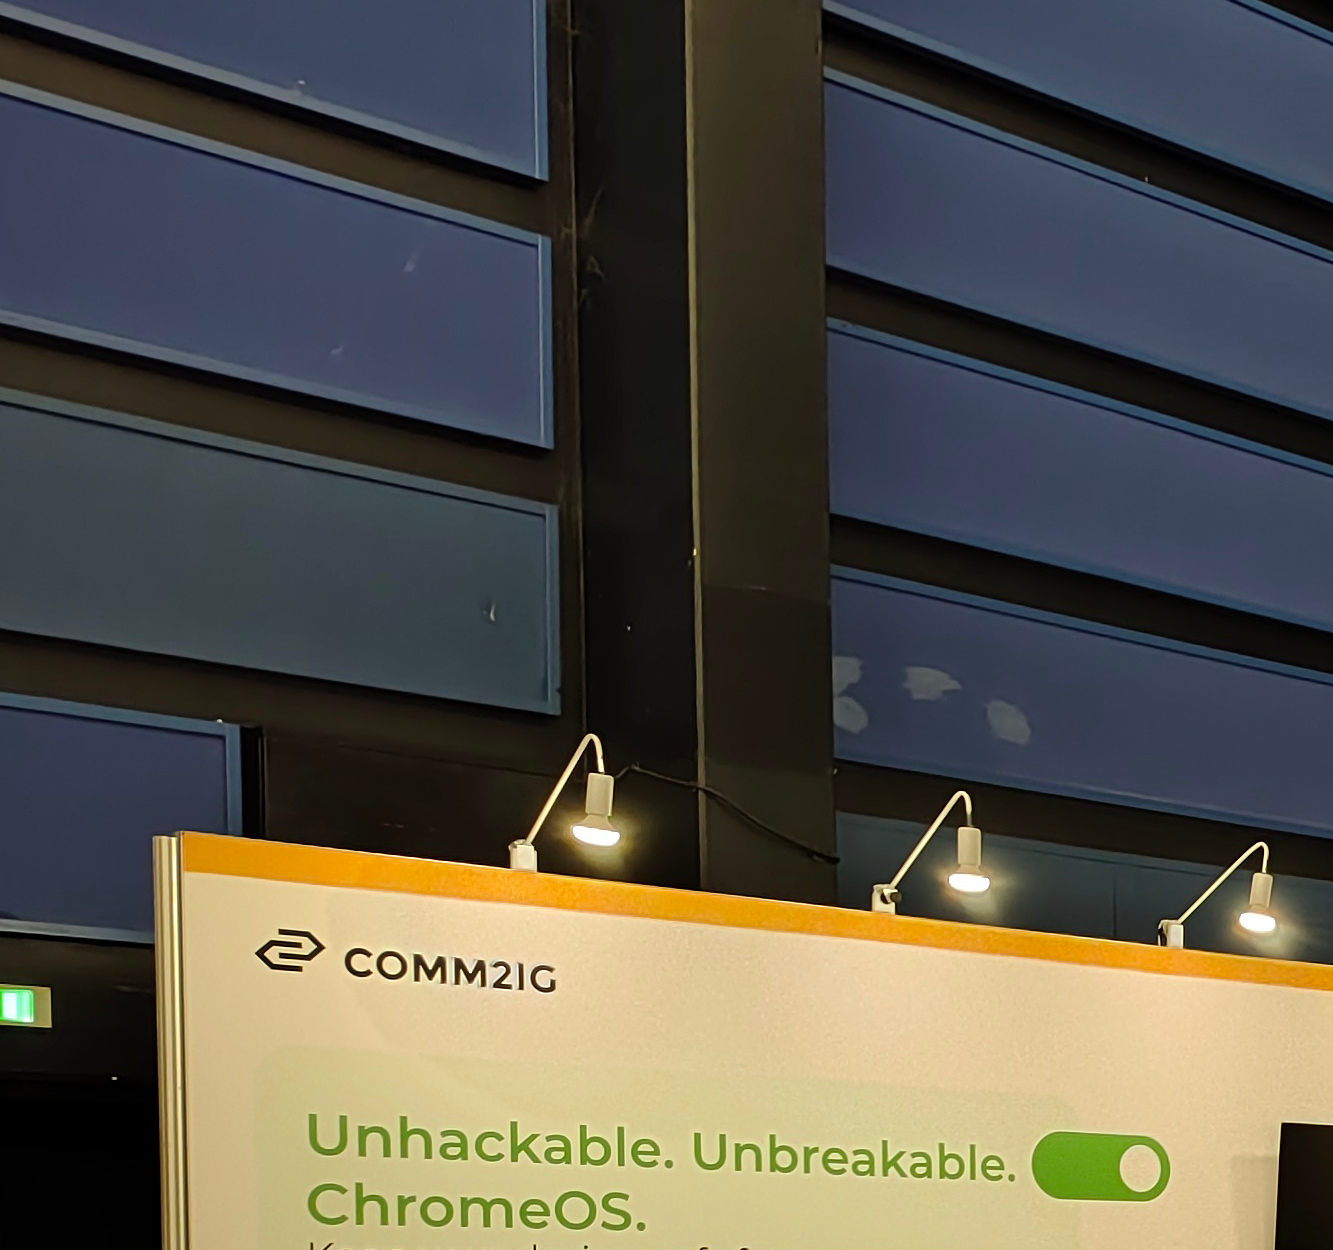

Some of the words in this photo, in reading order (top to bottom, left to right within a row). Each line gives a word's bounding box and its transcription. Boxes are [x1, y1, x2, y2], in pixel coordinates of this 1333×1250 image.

[344, 947, 558, 994] COMM2IG
[308, 1113, 674, 1169] Unhackable.
[693, 1132, 1016, 1182] Unbreakable.
[307, 1181, 647, 1231] ChromeOS.
